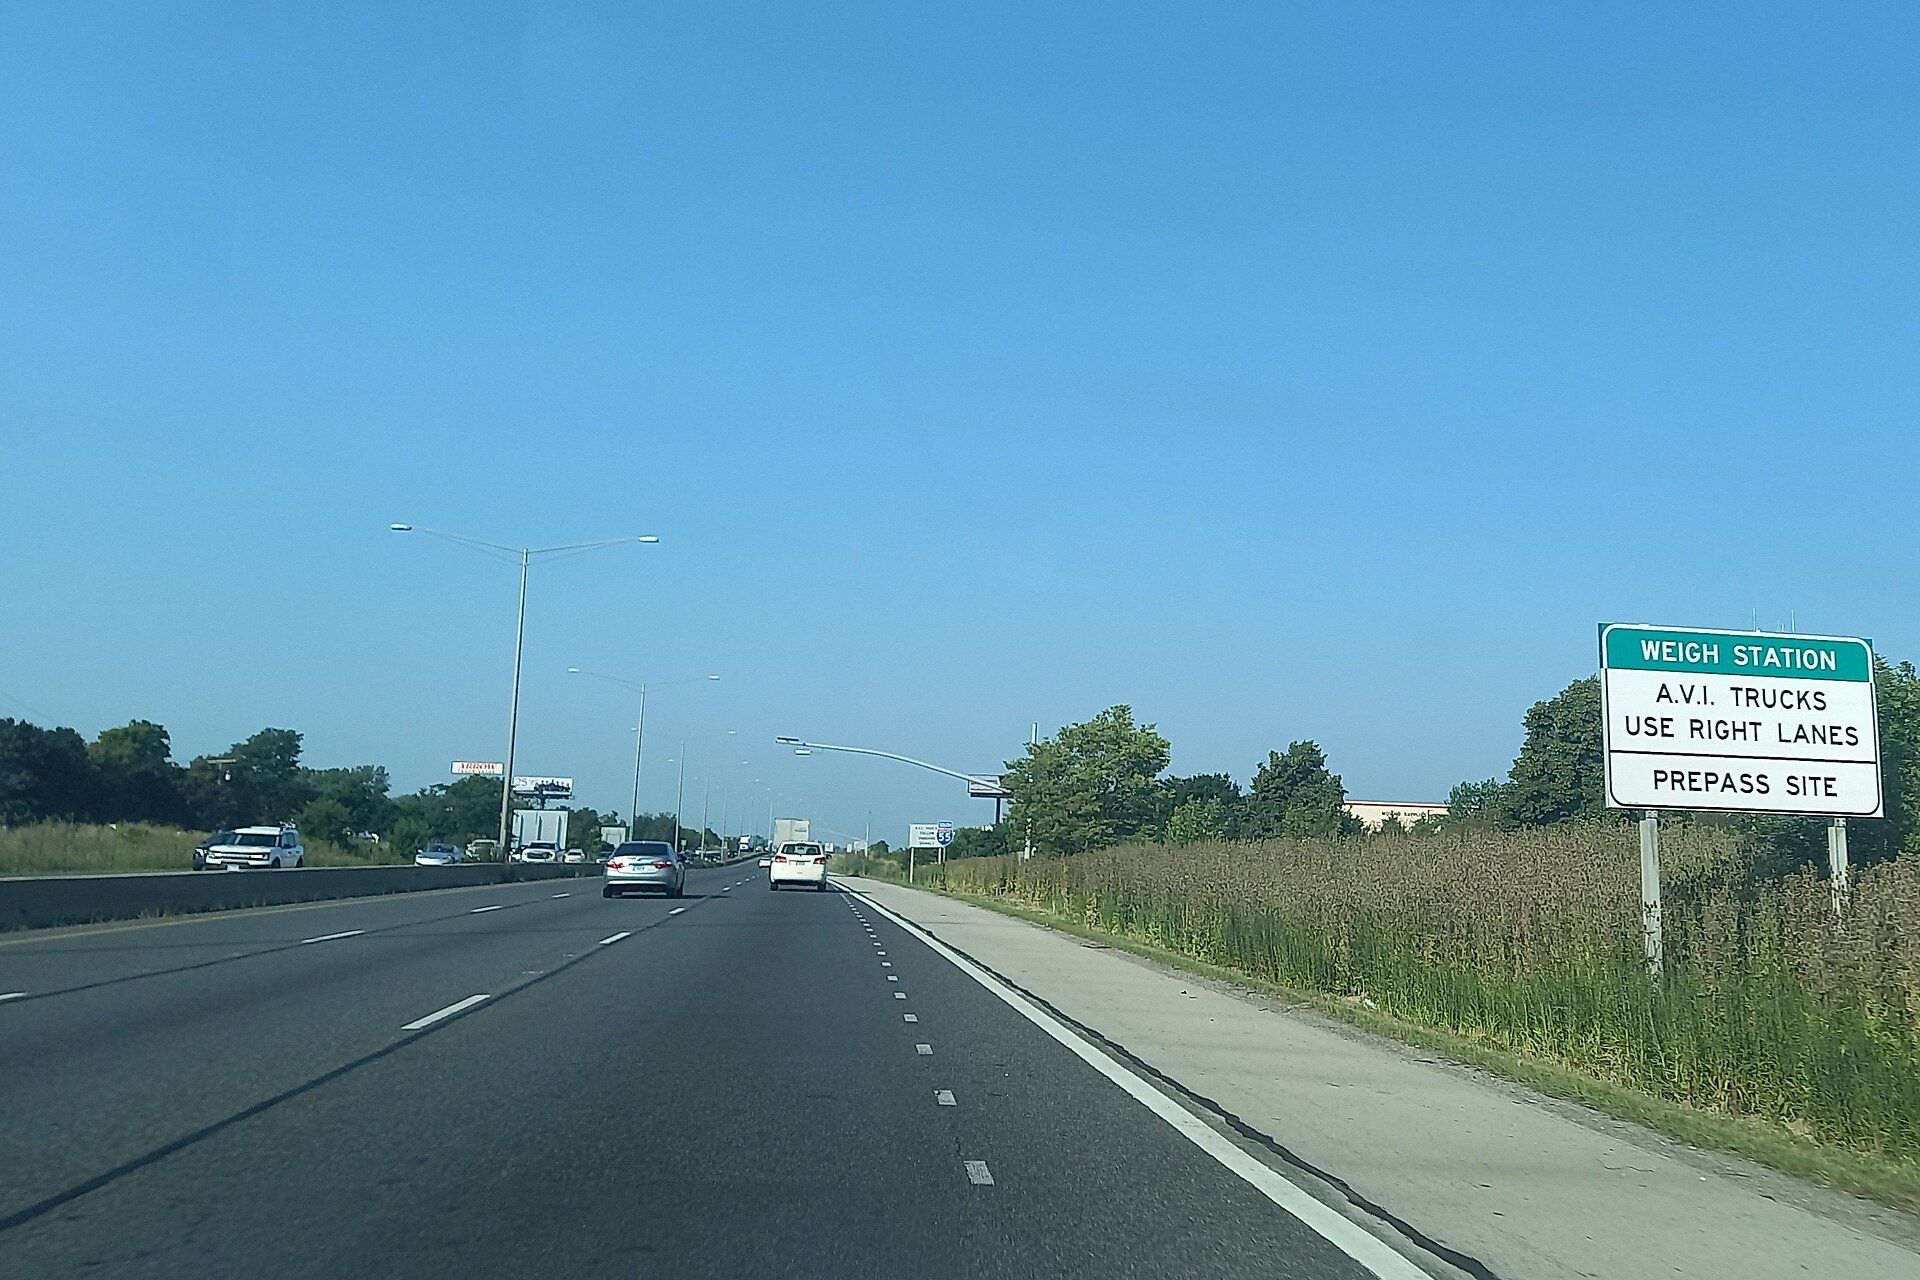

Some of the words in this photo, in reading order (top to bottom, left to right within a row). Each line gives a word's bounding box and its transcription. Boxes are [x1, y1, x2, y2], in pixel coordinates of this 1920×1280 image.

[1640, 639, 1719, 665] WEIGH
[1733, 645, 1838, 671] STATION
[1655, 683, 1715, 706] A.V.I.
[1730, 686, 1828, 711] TRUCKS
[1624, 715, 1675, 738] USE
[1689, 718, 1762, 742] RIGHT
[1778, 722, 1859, 747] LANES
[1653, 769, 1770, 795] PREPASS
[1786, 775, 1838, 798] SITE
[938, 832, 951, 842] 55
